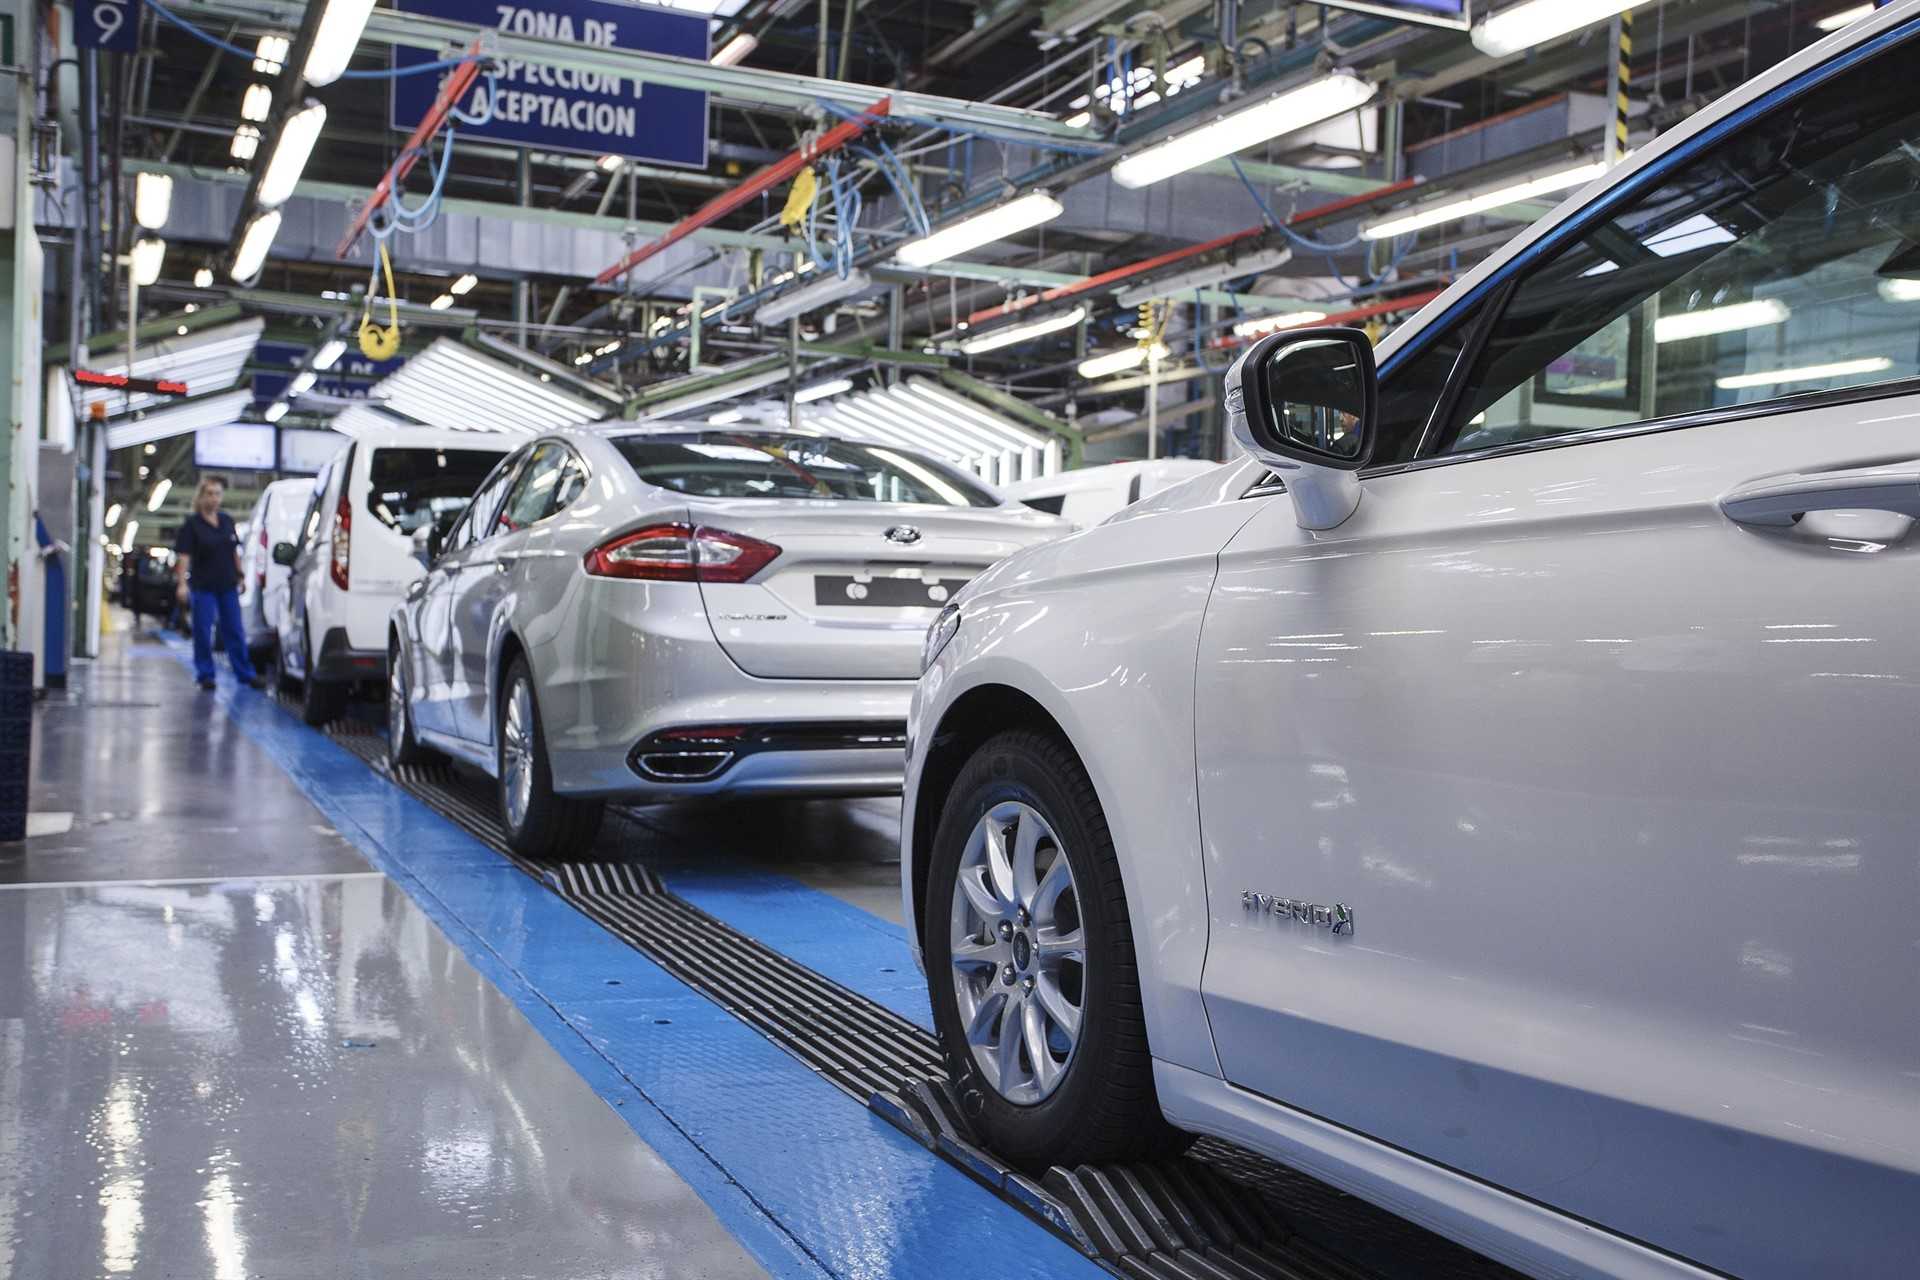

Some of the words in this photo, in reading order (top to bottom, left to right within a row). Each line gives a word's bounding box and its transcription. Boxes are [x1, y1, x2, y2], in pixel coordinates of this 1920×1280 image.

[93, 4, 123, 43] 9
[496, 5, 576, 42] ZONA
[469, 86, 636, 138] ACEPTACION
[1241, 889, 1332, 928] HYBRID
